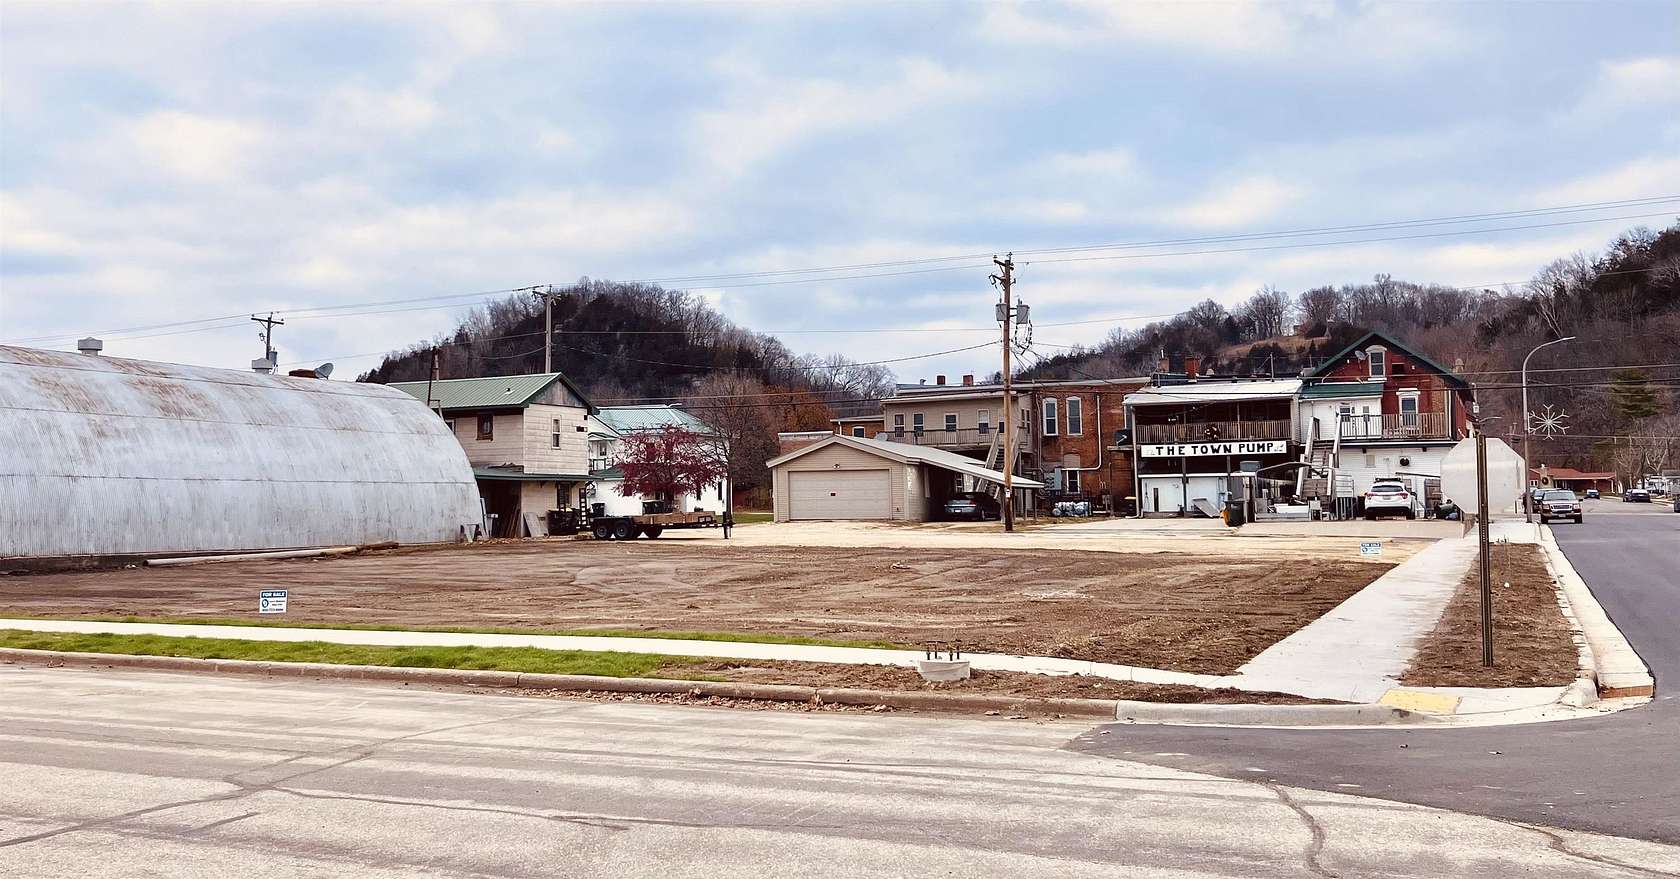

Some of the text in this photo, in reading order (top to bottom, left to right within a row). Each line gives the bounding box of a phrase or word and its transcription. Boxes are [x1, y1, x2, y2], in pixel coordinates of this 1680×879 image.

[1156, 442, 1274, 455] THE TOWN PUMP
